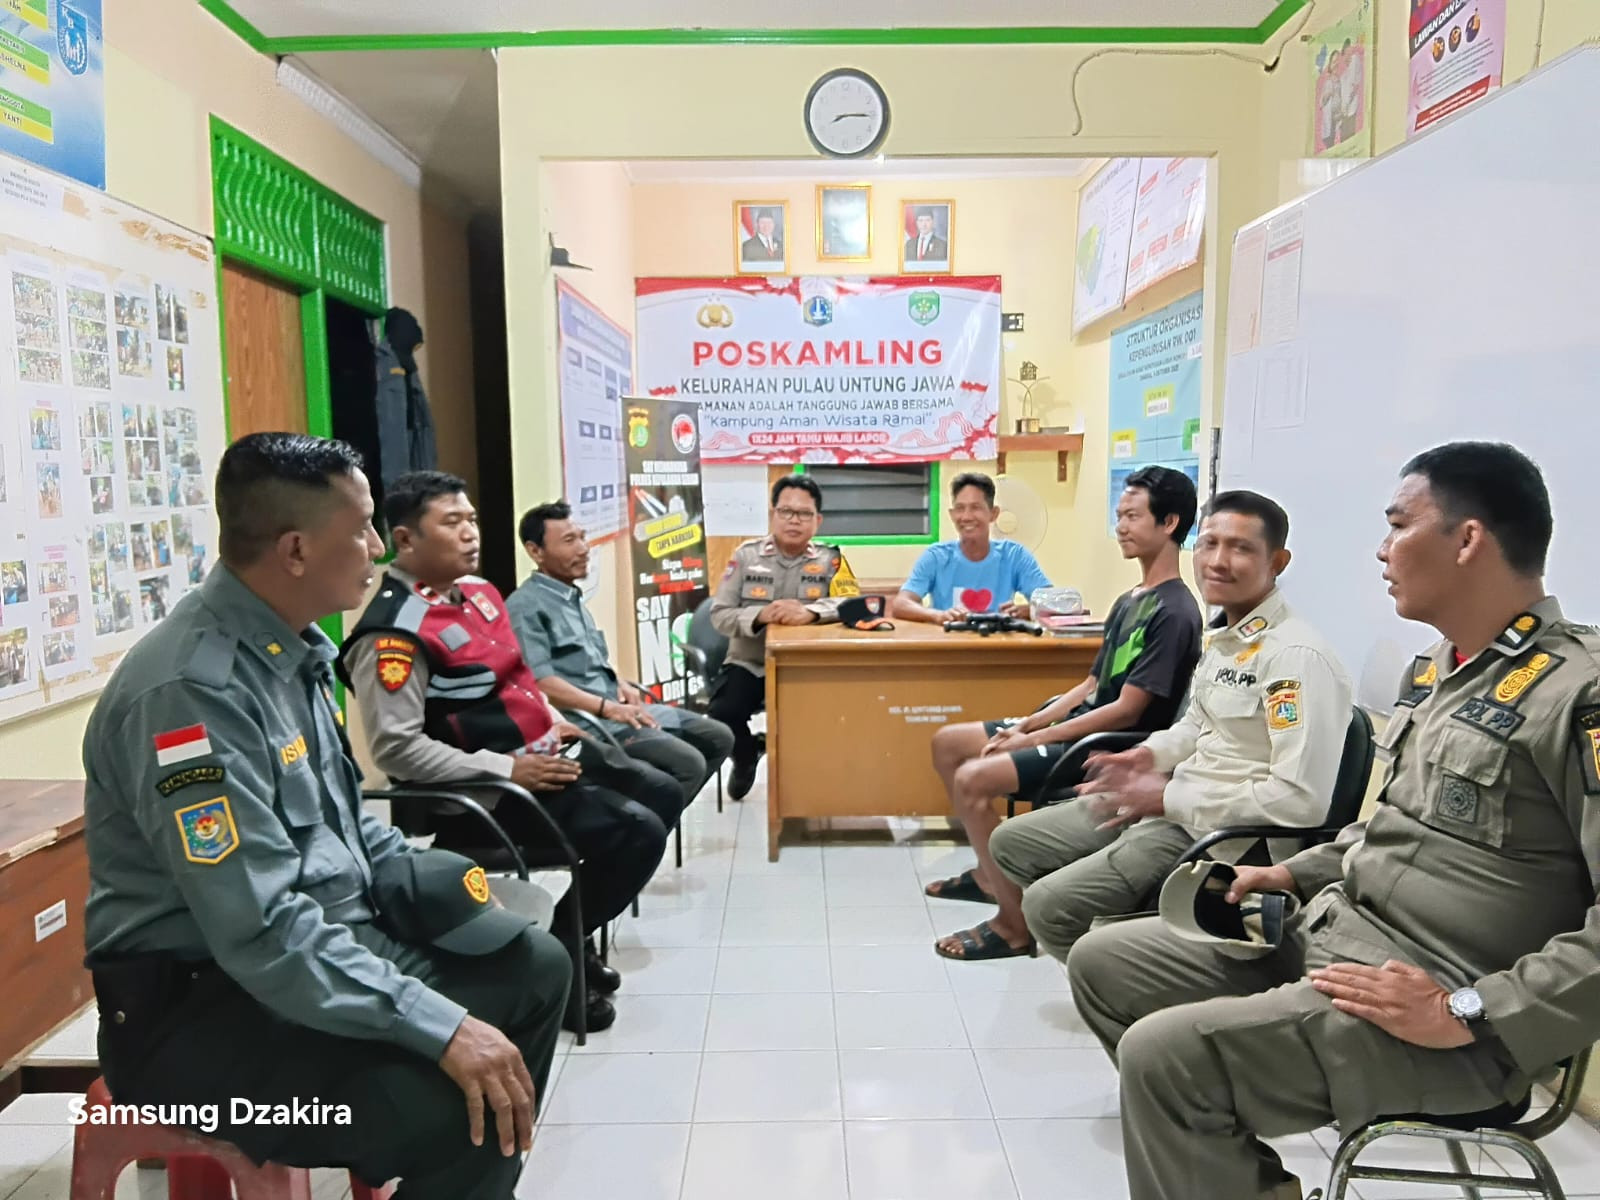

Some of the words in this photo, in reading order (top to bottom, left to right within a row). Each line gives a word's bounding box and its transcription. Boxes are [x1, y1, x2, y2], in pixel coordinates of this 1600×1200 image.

[1126, 324, 1159, 348] STRUKTUR
[692, 339, 943, 368] POSKAMLING
[680, 377, 778, 395] KELURAHAN
[783, 376, 835, 394] PULAU
[839, 376, 907, 393] UNTUNG
[910, 375, 955, 393] JAWA
[749, 400, 794, 412] ADALAH
[796, 399, 857, 412] TANGGUNG
[860, 399, 899, 411] JAWAB
[901, 396, 954, 410] BERSAMA
[779, 415, 819, 427] Aman
[824, 414, 878, 426] Wisata
[636, 594, 671, 621] SAY
[1485, 711, 1516, 730] PP
